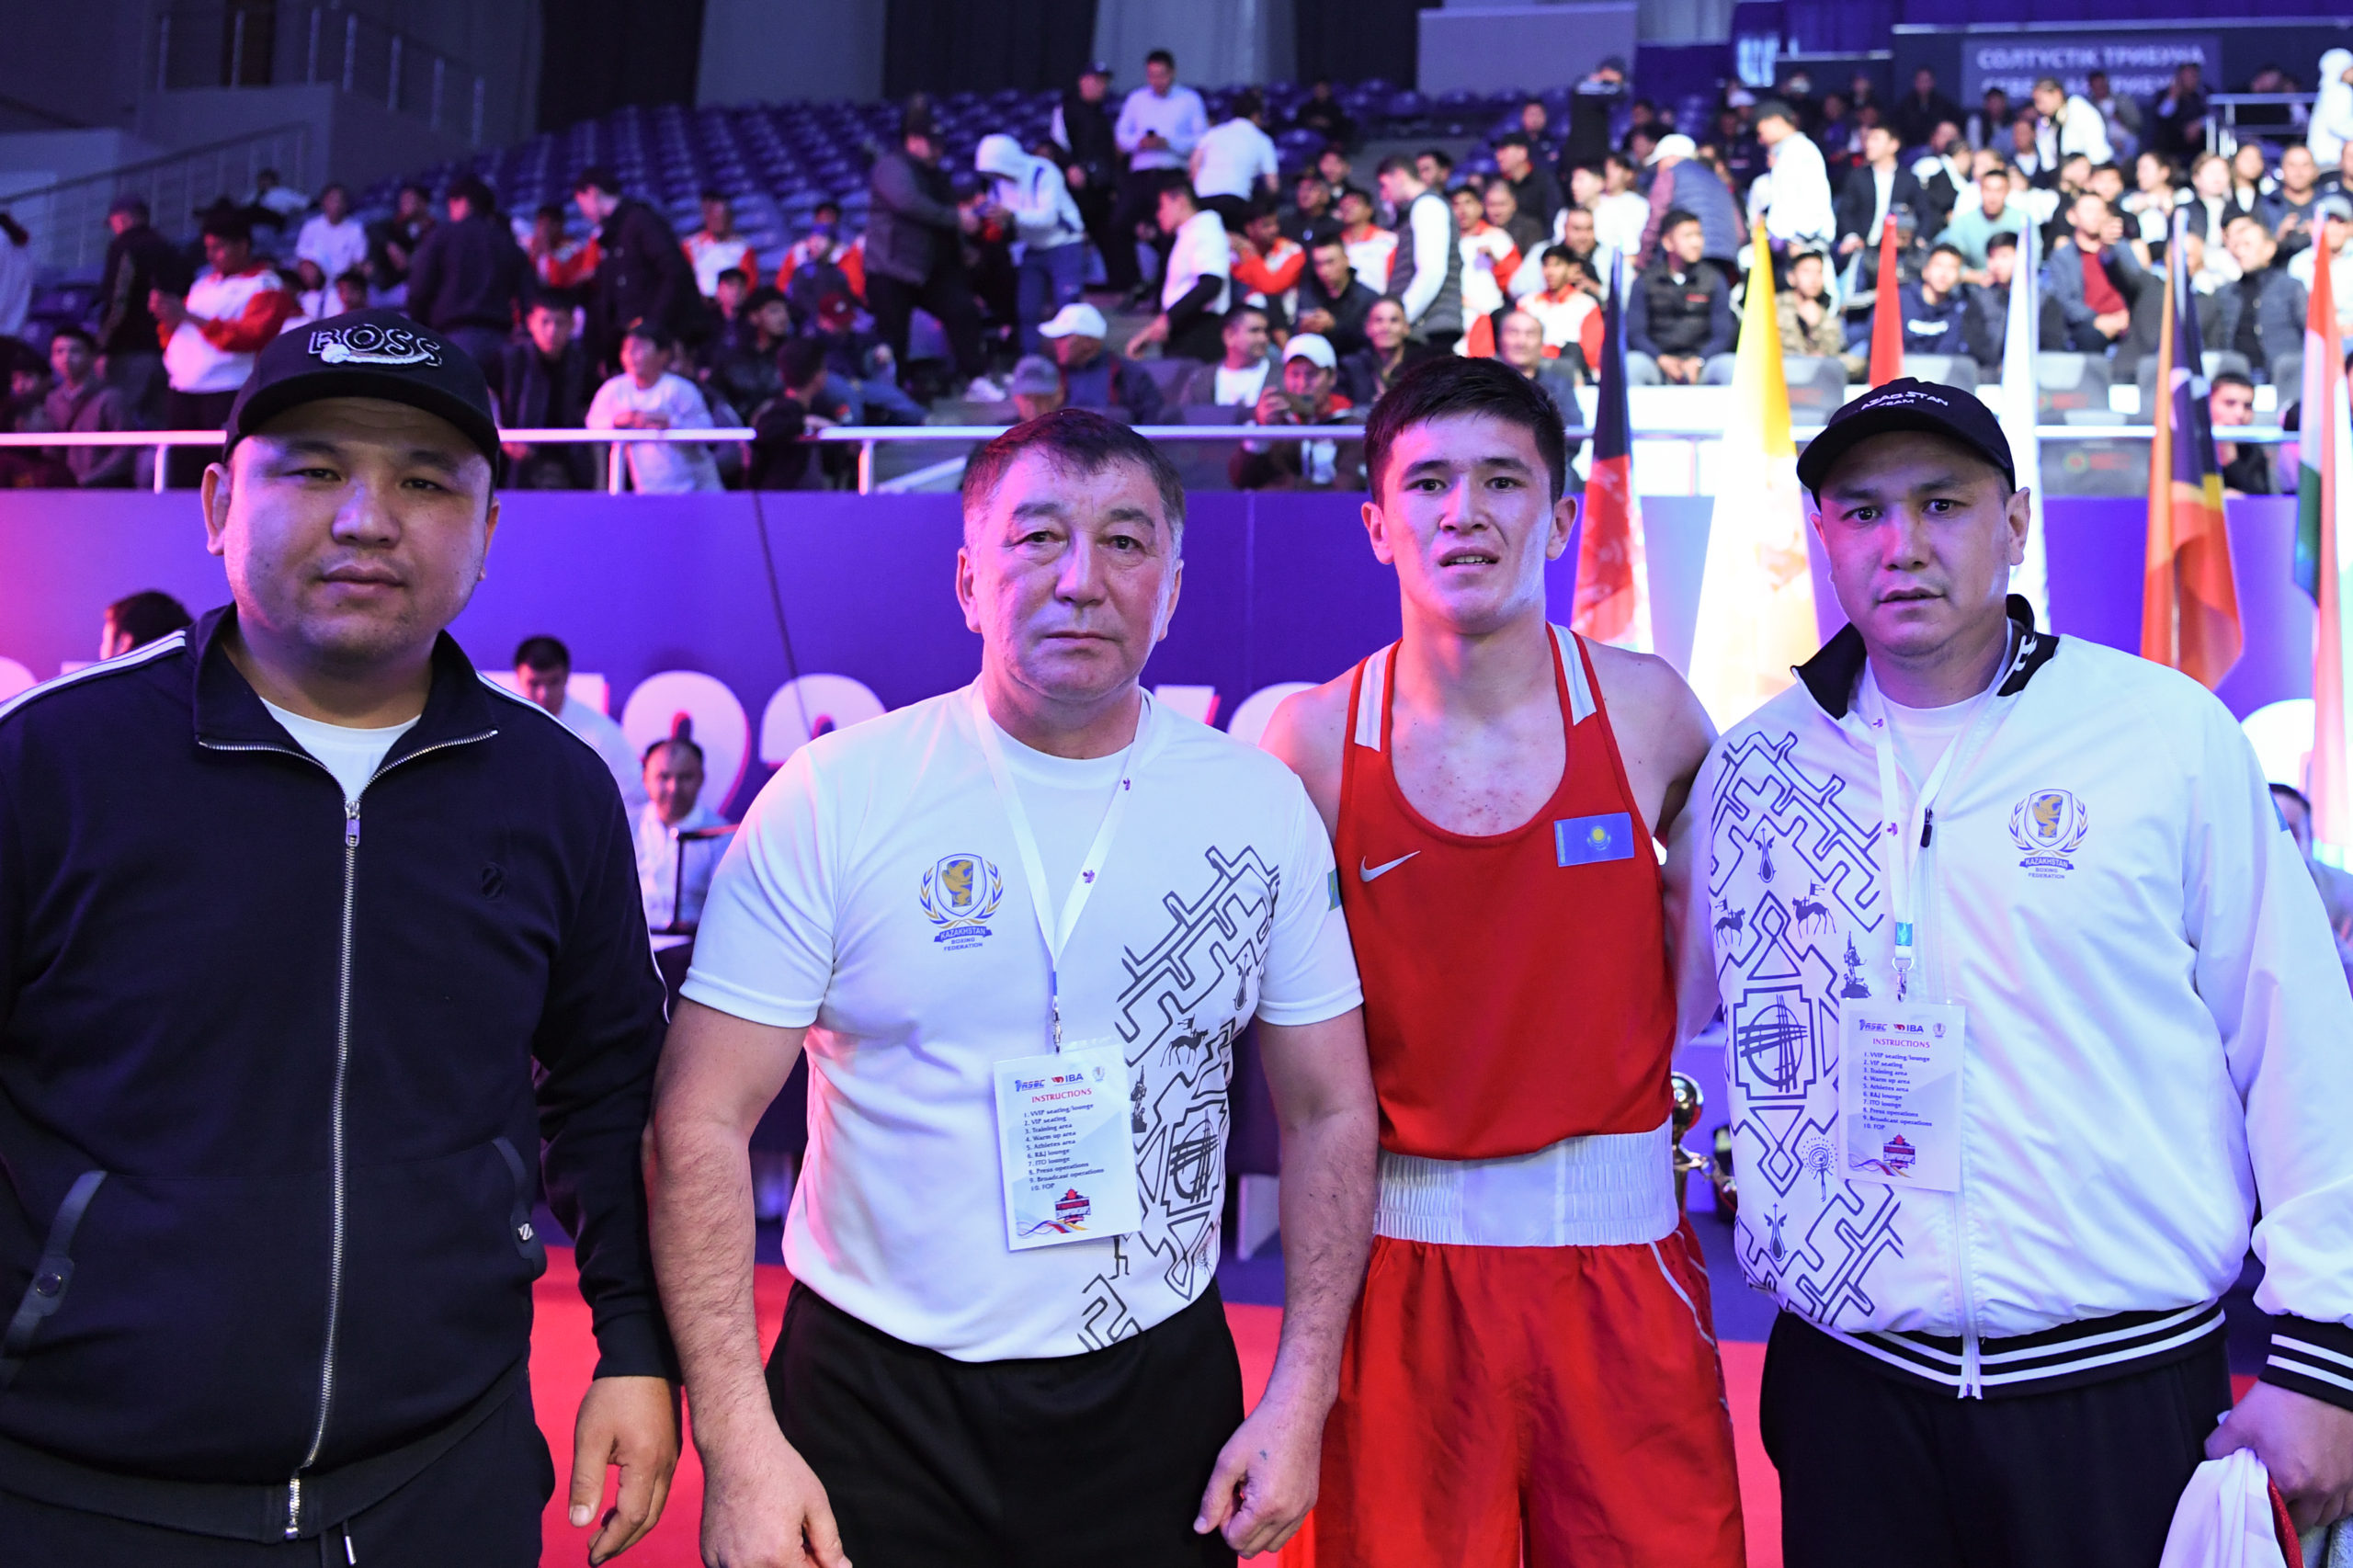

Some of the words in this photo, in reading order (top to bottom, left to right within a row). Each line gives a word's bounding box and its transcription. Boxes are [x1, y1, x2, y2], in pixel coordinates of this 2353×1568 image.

[308, 324, 442, 367] BOSS
[2025, 858, 2069, 868] KAZAKHSTAN
[940, 927, 986, 937] KAZAKHSTAN
[944, 943, 983, 951] FEDERATION
[1906, 1024, 1924, 1033] IBA
[1872, 1038, 1930, 1049] INSTRUCTIONS
[1065, 1073, 1084, 1083] IBA
[1031, 1088, 1092, 1104] INSTRUCTIONS
